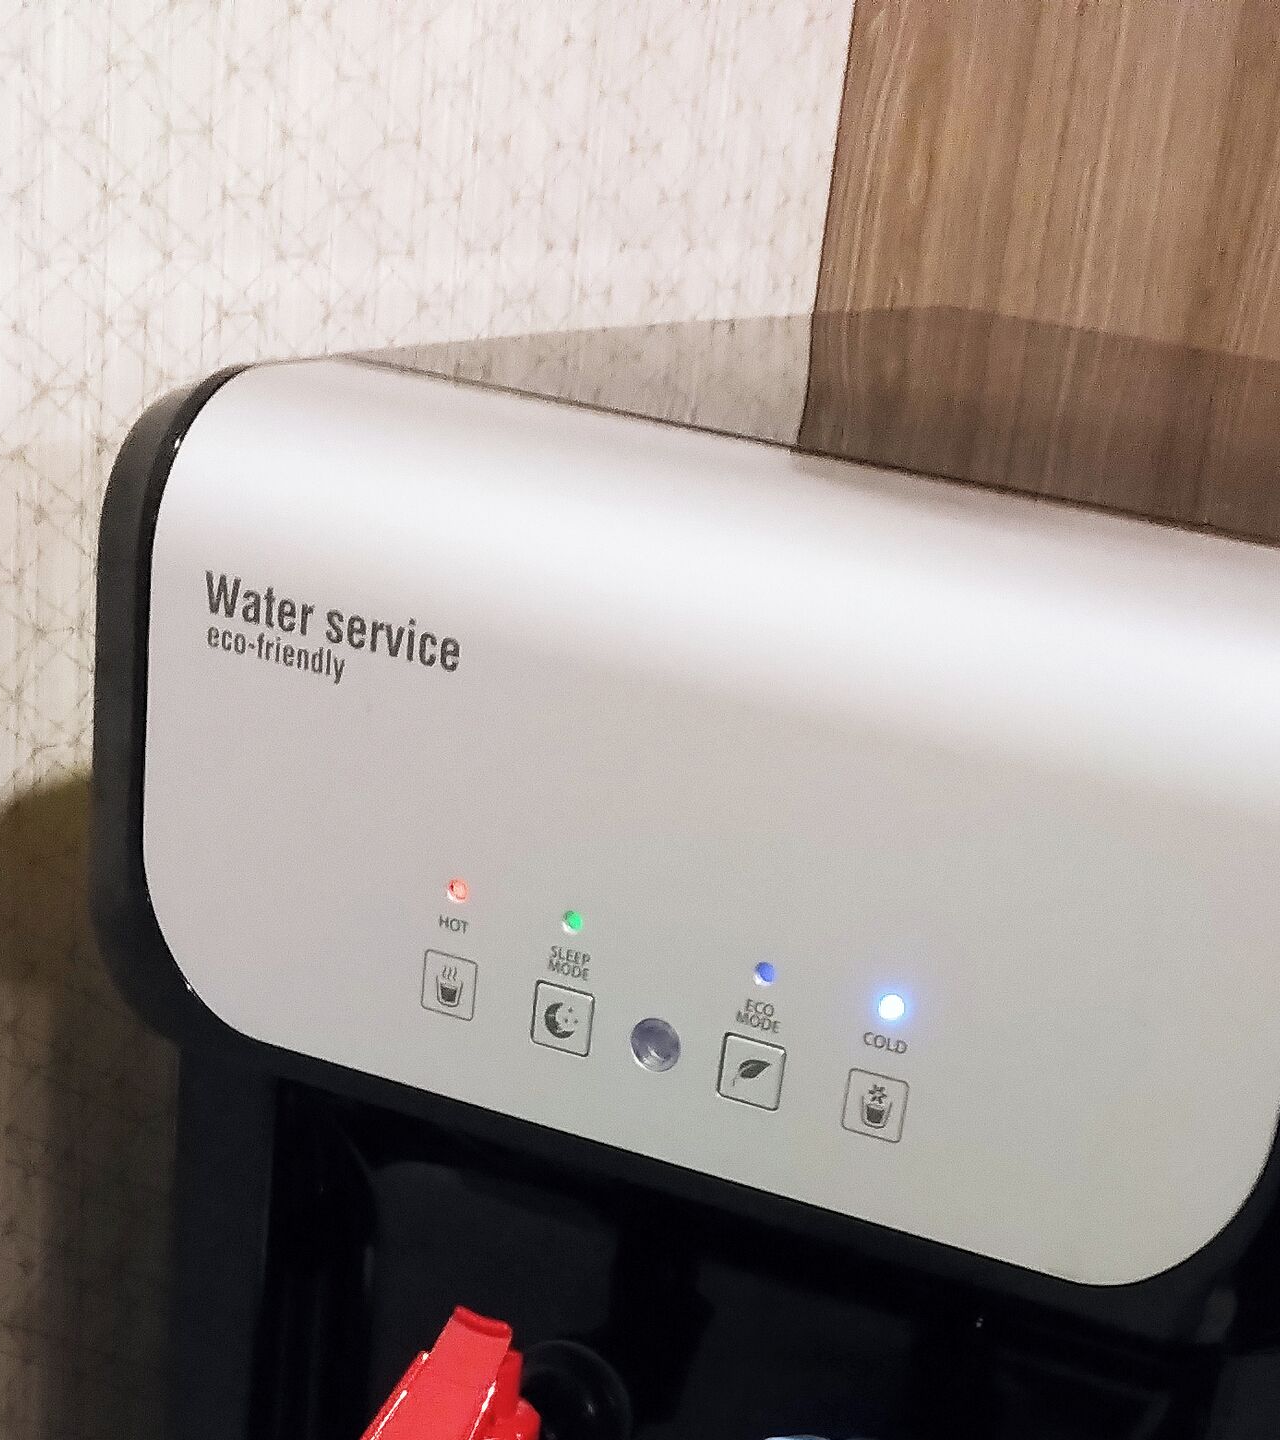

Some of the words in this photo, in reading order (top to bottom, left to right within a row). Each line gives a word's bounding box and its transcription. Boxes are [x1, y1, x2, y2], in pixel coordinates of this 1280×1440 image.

[205, 569, 315, 636] Water
[325, 608, 461, 673] service
[206, 625, 346, 685] eco-friendly
[439, 914, 469, 934] HOT
[550, 944, 591, 966] SLEEP
[547, 959, 590, 981] MODE
[745, 998, 774, 1017] ECO
[736, 1010, 781, 1033] MODE
[862, 1031, 908, 1054] COLD
